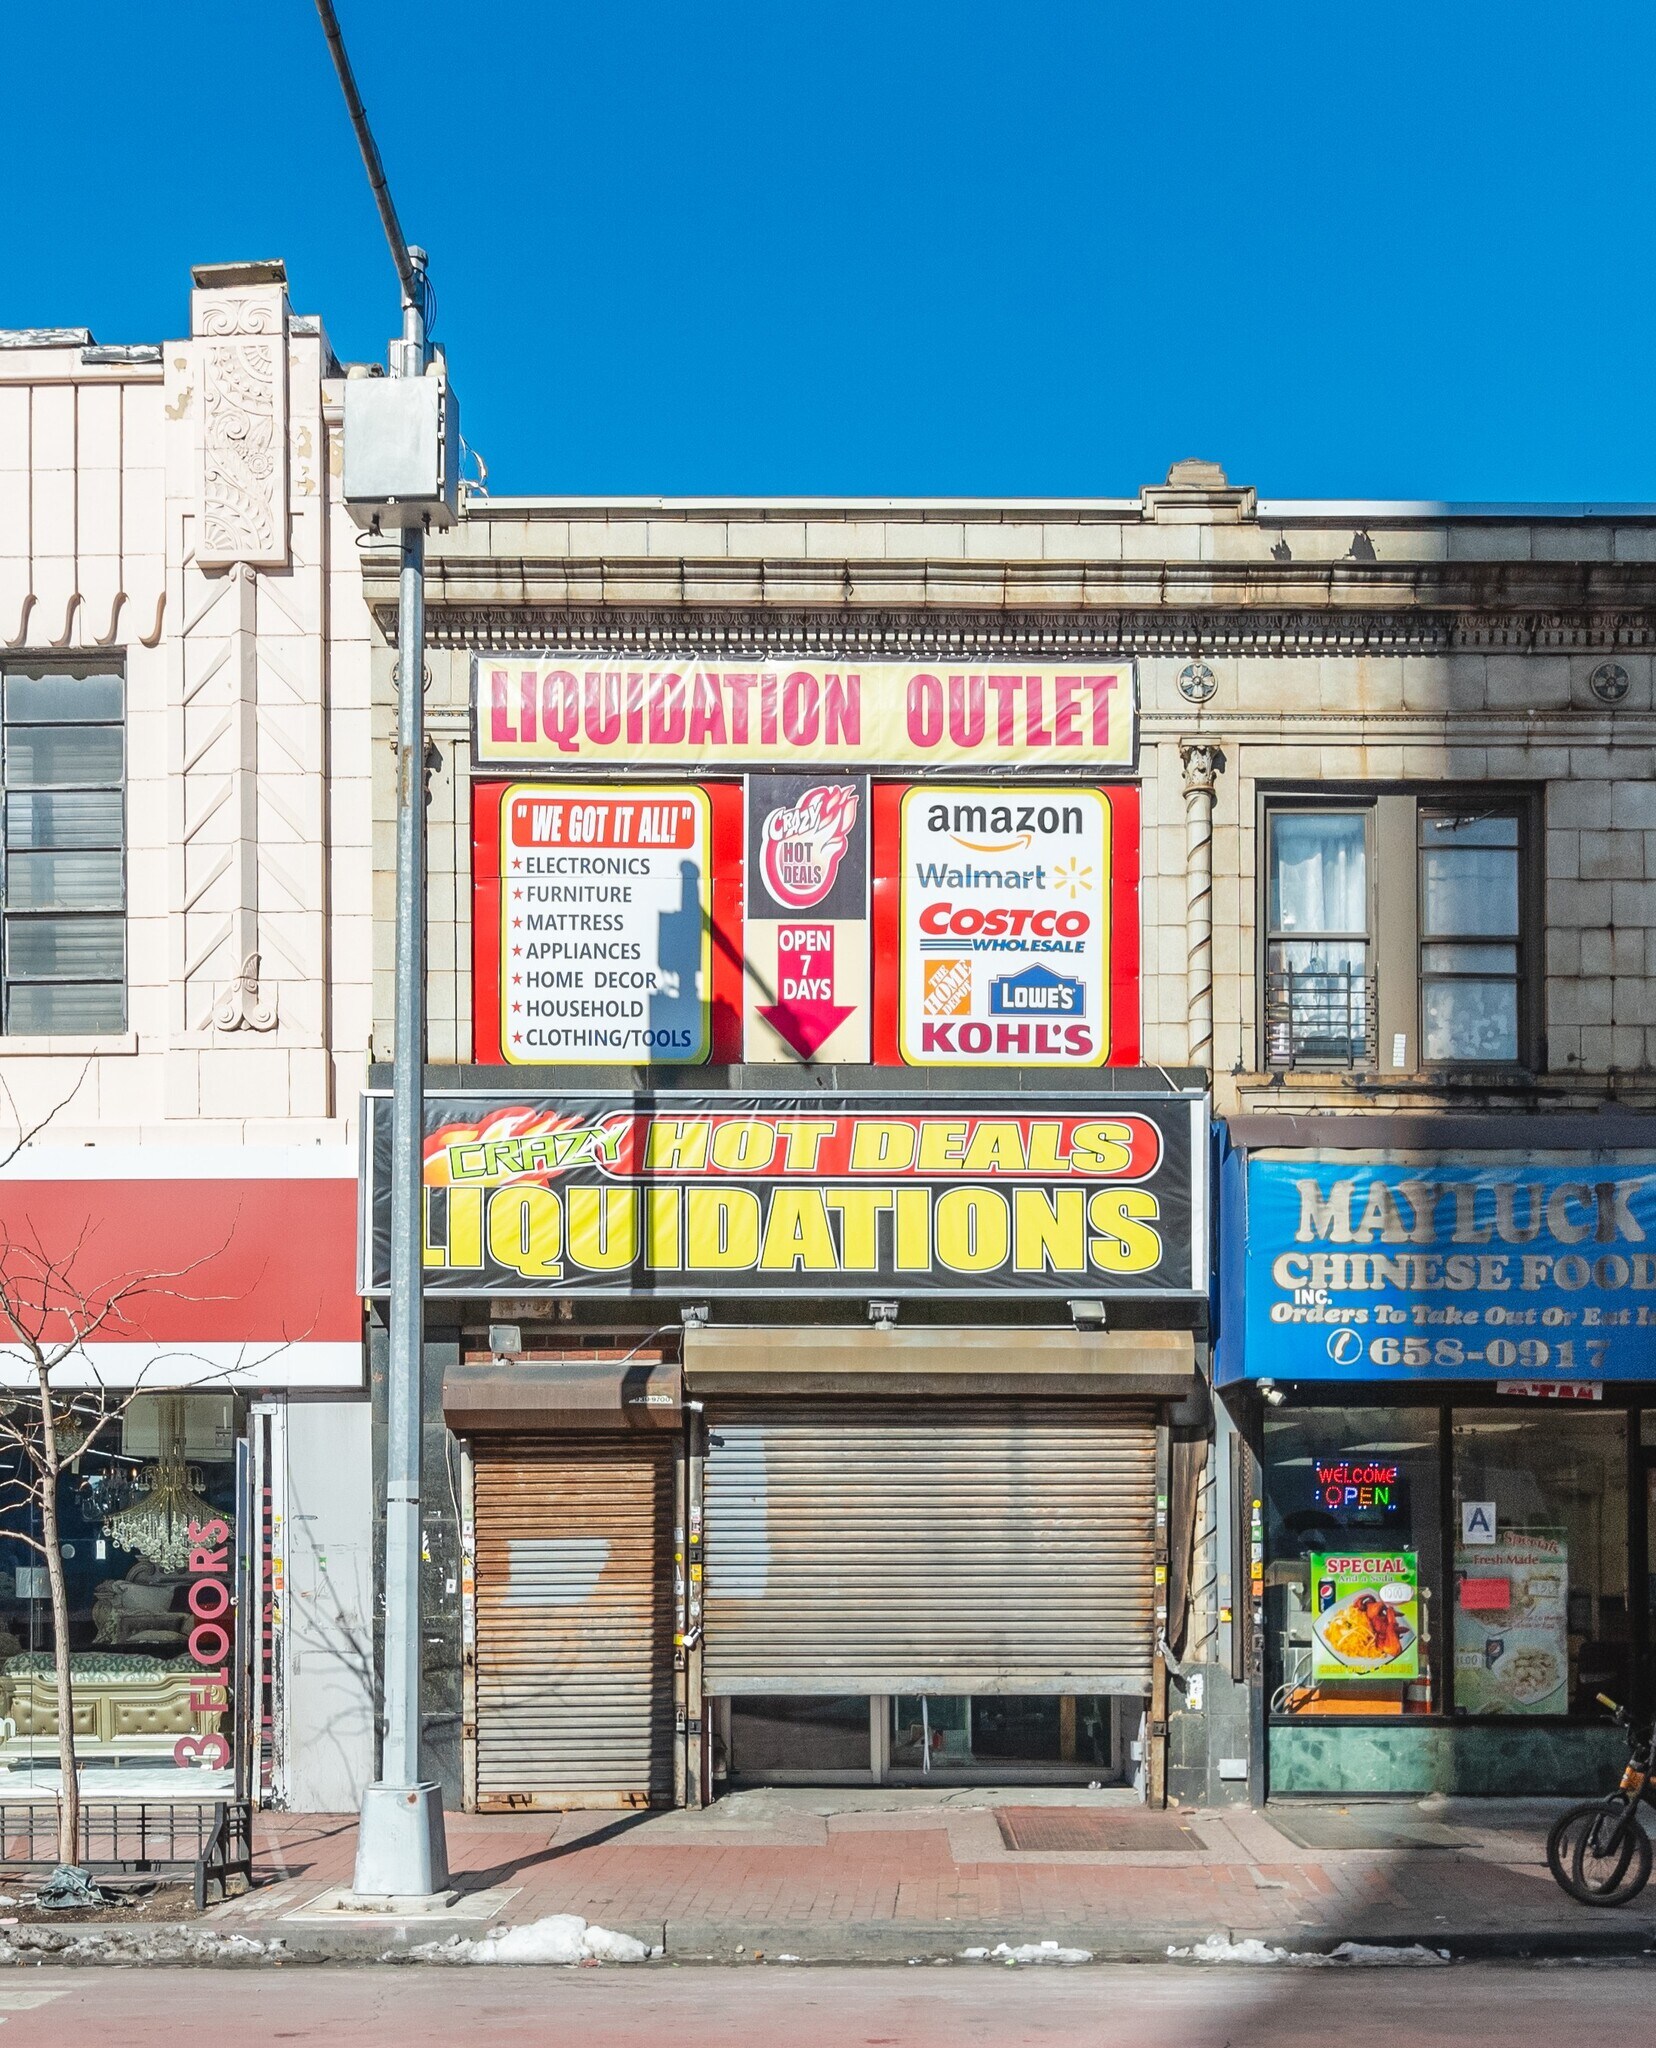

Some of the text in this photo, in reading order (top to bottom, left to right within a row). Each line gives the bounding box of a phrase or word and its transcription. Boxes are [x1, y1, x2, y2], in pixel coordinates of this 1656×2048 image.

[491, 670, 1118, 752] LIQUIDATION OUTLET
[568, 804, 609, 843] GOT
[613, 805, 635, 843] IT
[769, 803, 822, 842] CRAZY
[927, 804, 1083, 834] amazon
[783, 842, 814, 863] HOT
[526, 857, 650, 875] ELECTRONICS
[783, 865, 822, 884] DEALS
[915, 863, 1046, 890] Walmart
[526, 886, 632, 903] FURNITURE
[526, 914, 624, 931] MATTRESS
[918, 902, 1091, 938] COSTCO
[526, 942, 641, 960] APPLIANCES
[779, 929, 831, 952] OPEN
[971, 938, 1086, 954] WHOLESALE
[799, 954, 812, 976] 7
[928, 964, 951, 988] THE
[526, 971, 658, 989] HOME DECOR
[783, 978, 832, 1000] DAYS
[924, 958, 971, 1016] HOME
[942, 980, 972, 1016] DEPOT
[1002, 982, 1074, 1010] LOWE'S
[526, 1000, 644, 1018] HOUSEHOLD
[526, 1029, 692, 1049] CLOTHING/TOOLS
[922, 1022, 1094, 1056] KOHL'S
[448, 1124, 630, 1181] CRAZY
[643, 1119, 1132, 1174] HOT DEALS
[1272, 1252, 1656, 1291] CHINESE FOOD
[1294, 1288, 1333, 1305] INC.
[1270, 1302, 1369, 1324] Orders
[1373, 1304, 1407, 1324] To
[1411, 1304, 1479, 1325] Take
[1484, 1306, 1538, 1326] Out
[1541, 1306, 1578, 1326] Or
[1581, 1306, 1631, 1326] Eat
[1369, 1337, 1611, 1368] 658-0917
[1318, 1467, 1395, 1484] WELCOME
[1325, 1485, 1389, 1505] OPEN
[1467, 1506, 1491, 1532] A
[1327, 1558, 1406, 1574] SPECIAL
[1472, 1553, 1540, 1565] Fresh Made
[1338, 1575, 1358, 1583] And
[173, 1518, 230, 1771] 3 FLOORS
